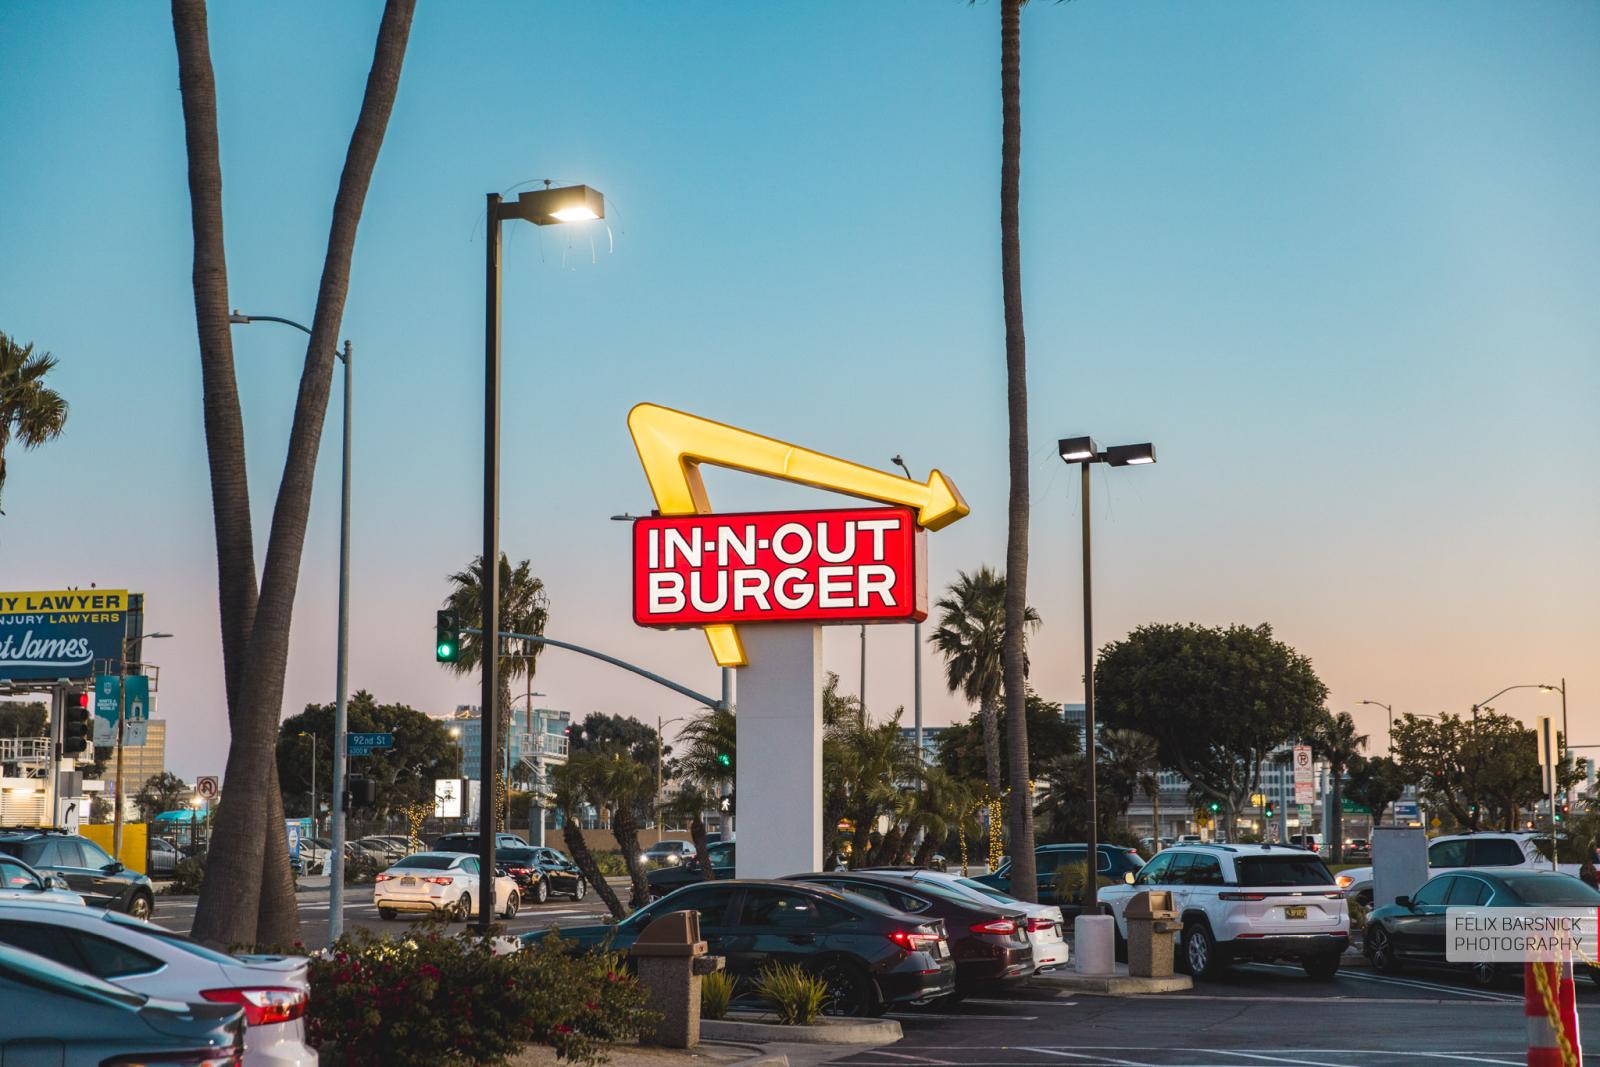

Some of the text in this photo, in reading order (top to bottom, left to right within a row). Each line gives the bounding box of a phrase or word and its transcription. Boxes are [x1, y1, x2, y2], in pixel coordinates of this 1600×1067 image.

[648, 519, 900, 568] IN-N-OUT
[648, 564, 897, 614] BURGER
[26, 595, 120, 610] LAWYER
[49, 613, 120, 624] LAWYERS
[353, 735, 386, 745] 92nd St
